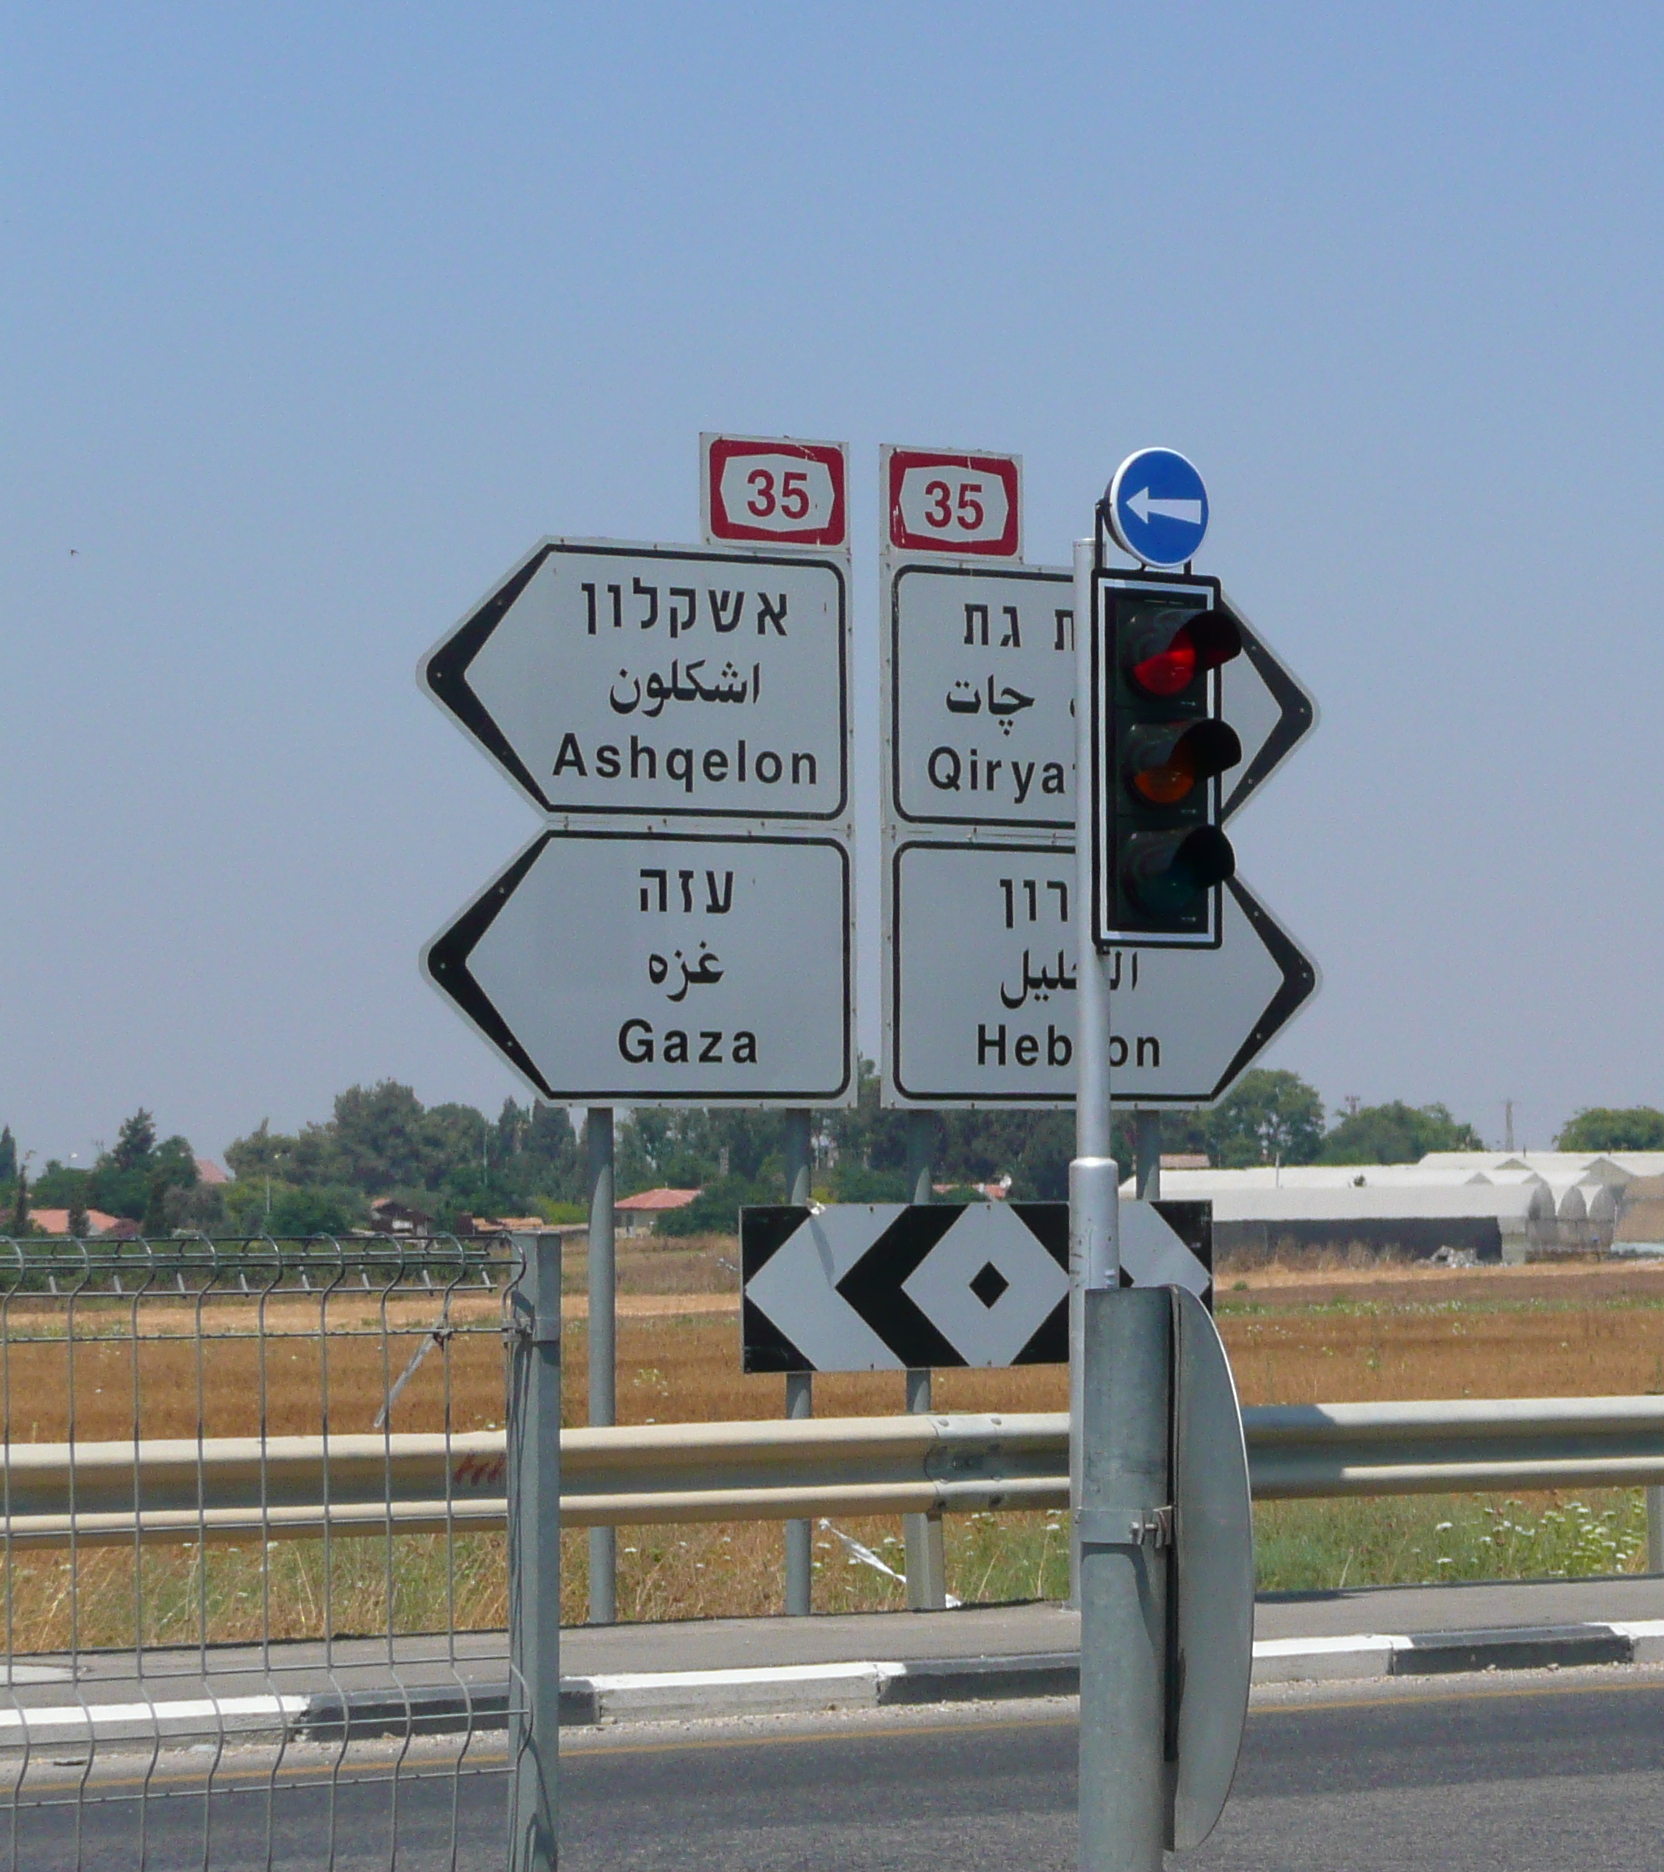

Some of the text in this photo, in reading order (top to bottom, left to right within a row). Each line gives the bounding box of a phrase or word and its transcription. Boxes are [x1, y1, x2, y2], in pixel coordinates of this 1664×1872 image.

[746, 468, 810, 520] 35
[924, 480, 984, 531] 35
[580, 576, 788, 639] אשקלון
[963, 603, 1021, 648] גת
[608, 657, 761, 718] اشكلون
[551, 732, 818, 794] Ashqelon
[927, 745, 1076, 805] Qirya
[639, 868, 734, 915] עזה
[999, 877, 1069, 930] רון
[1000, 948, 1138, 1010] الليل
[617, 1017, 758, 1064] Gaza
[977, 1023, 1160, 1068] Hebon
